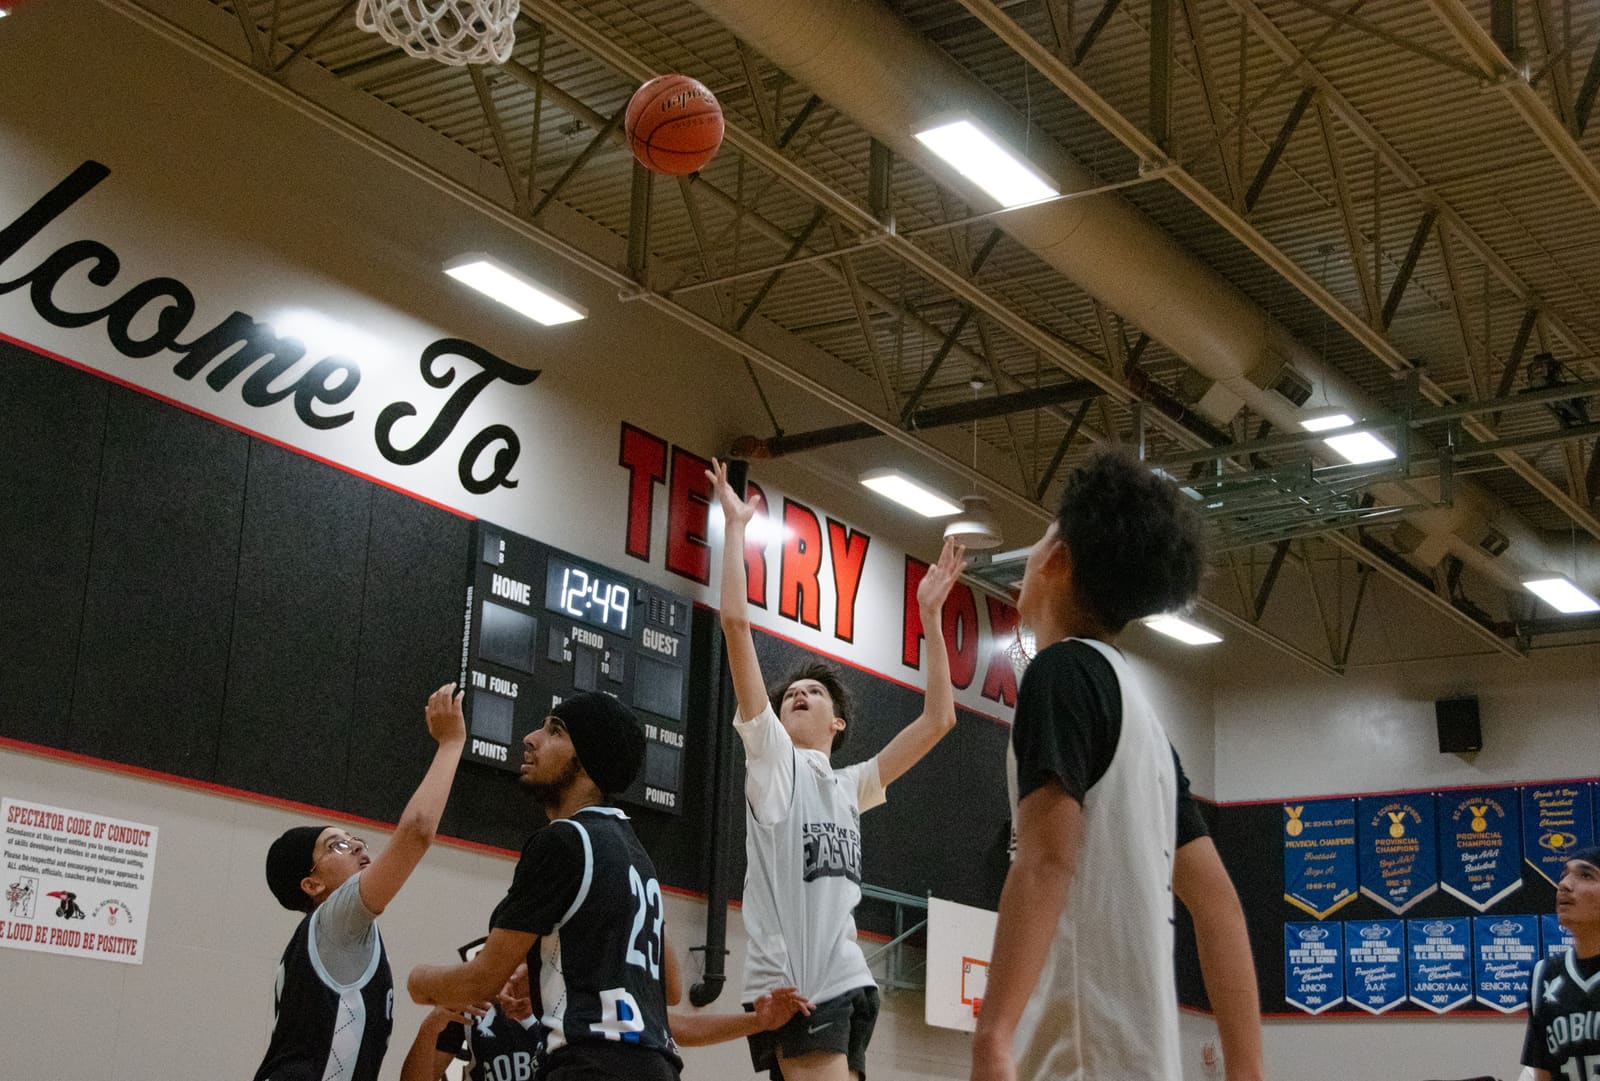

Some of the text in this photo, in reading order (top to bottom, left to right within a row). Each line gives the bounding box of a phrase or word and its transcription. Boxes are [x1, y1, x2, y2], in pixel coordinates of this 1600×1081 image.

[374, 338, 542, 494] To
[492, 573, 531, 606] HOME
[560, 568, 630, 630] 12:49
[572, 626, 604, 649] PERIOD
[642, 628, 678, 657] GUEST
[472, 670, 518, 698] TM FOULS
[644, 724, 684, 748] TM FOULS
[472, 739, 508, 762] POINTS
[646, 786, 676, 808] POINTS
[7, 805, 151, 847] SPECTATOR CODE OF CONDUCT
[626, 864, 664, 980] 23
[7, 921, 33, 942] LOUD
[35, 926, 48, 944] BE
[50, 928, 81, 948] PROUD
[82, 932, 96, 950] BE
[97, 934, 138, 956] POSITIVE
[1298, 984, 1327, 992] JUNIOR
[1414, 983, 1444, 991] JUNIOR
[1481, 982, 1511, 991] SENIOR
